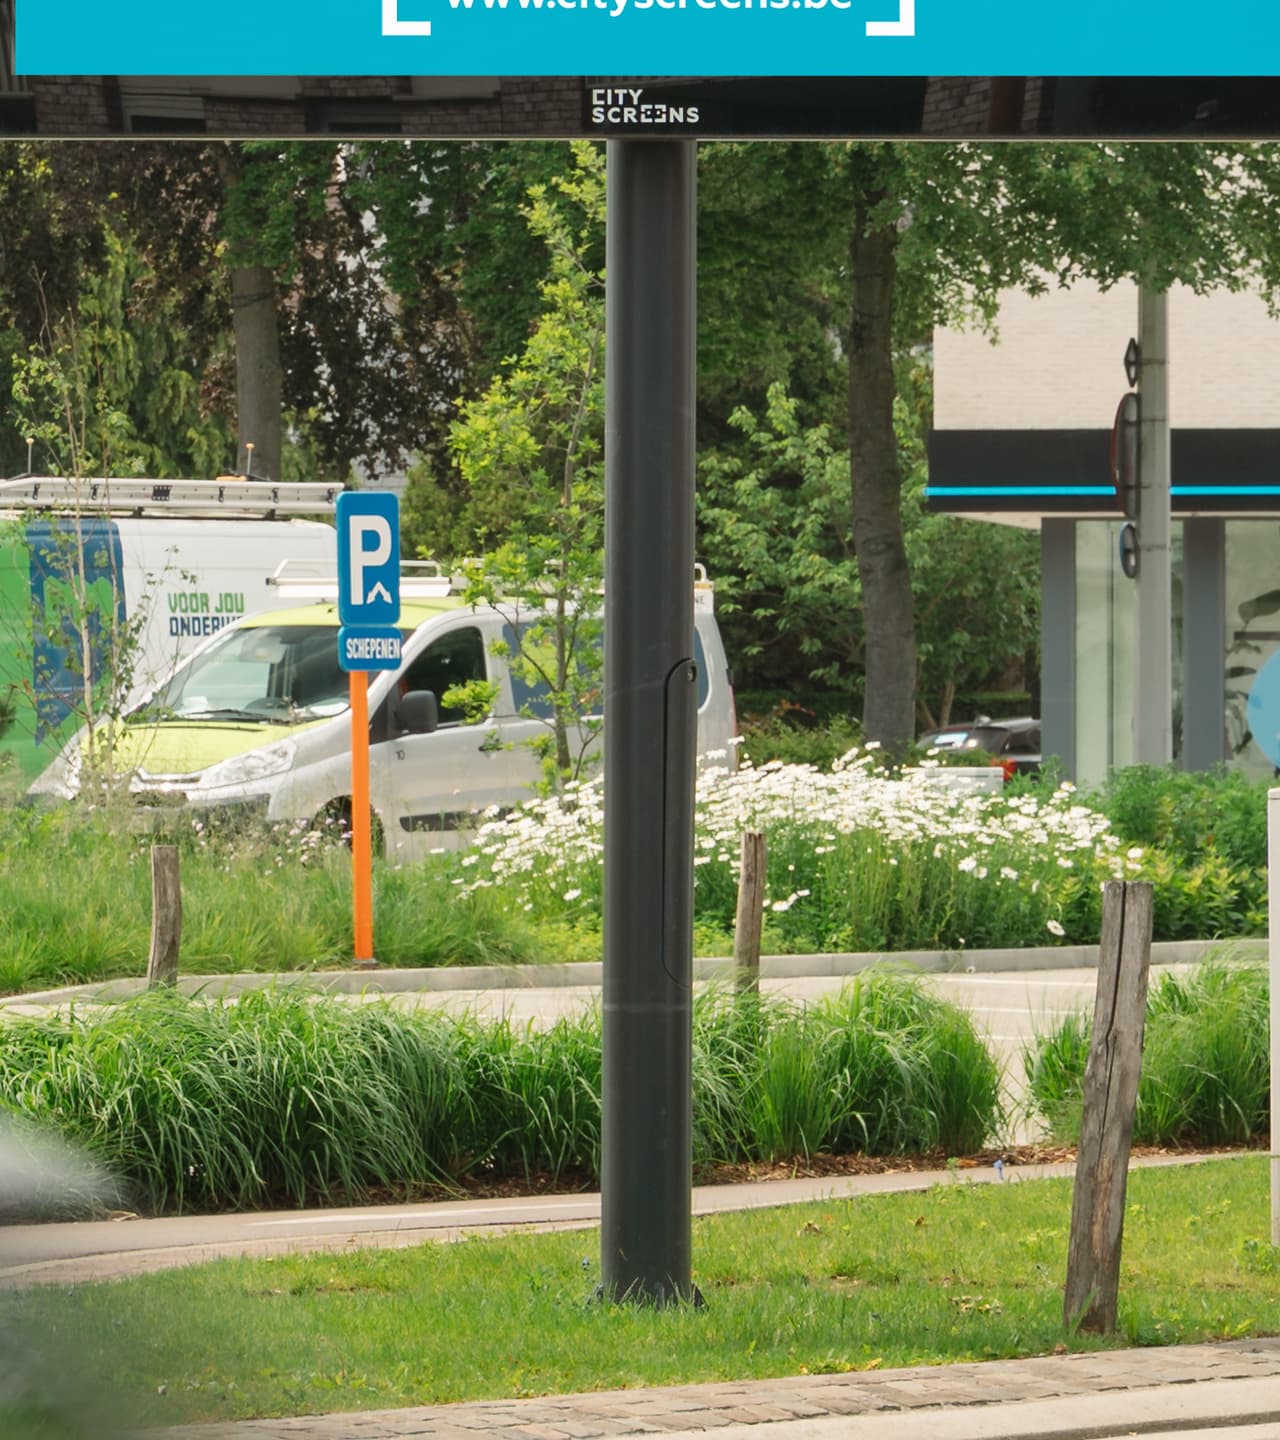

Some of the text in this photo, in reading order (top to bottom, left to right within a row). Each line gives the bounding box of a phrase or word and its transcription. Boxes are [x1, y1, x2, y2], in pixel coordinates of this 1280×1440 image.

[592, 88, 643, 105] CITY
[591, 104, 700, 123] SCREENS
[349, 514, 392, 606] P
[167, 591, 245, 614] VOOR JOU
[346, 637, 401, 660] SCHEPENEN
